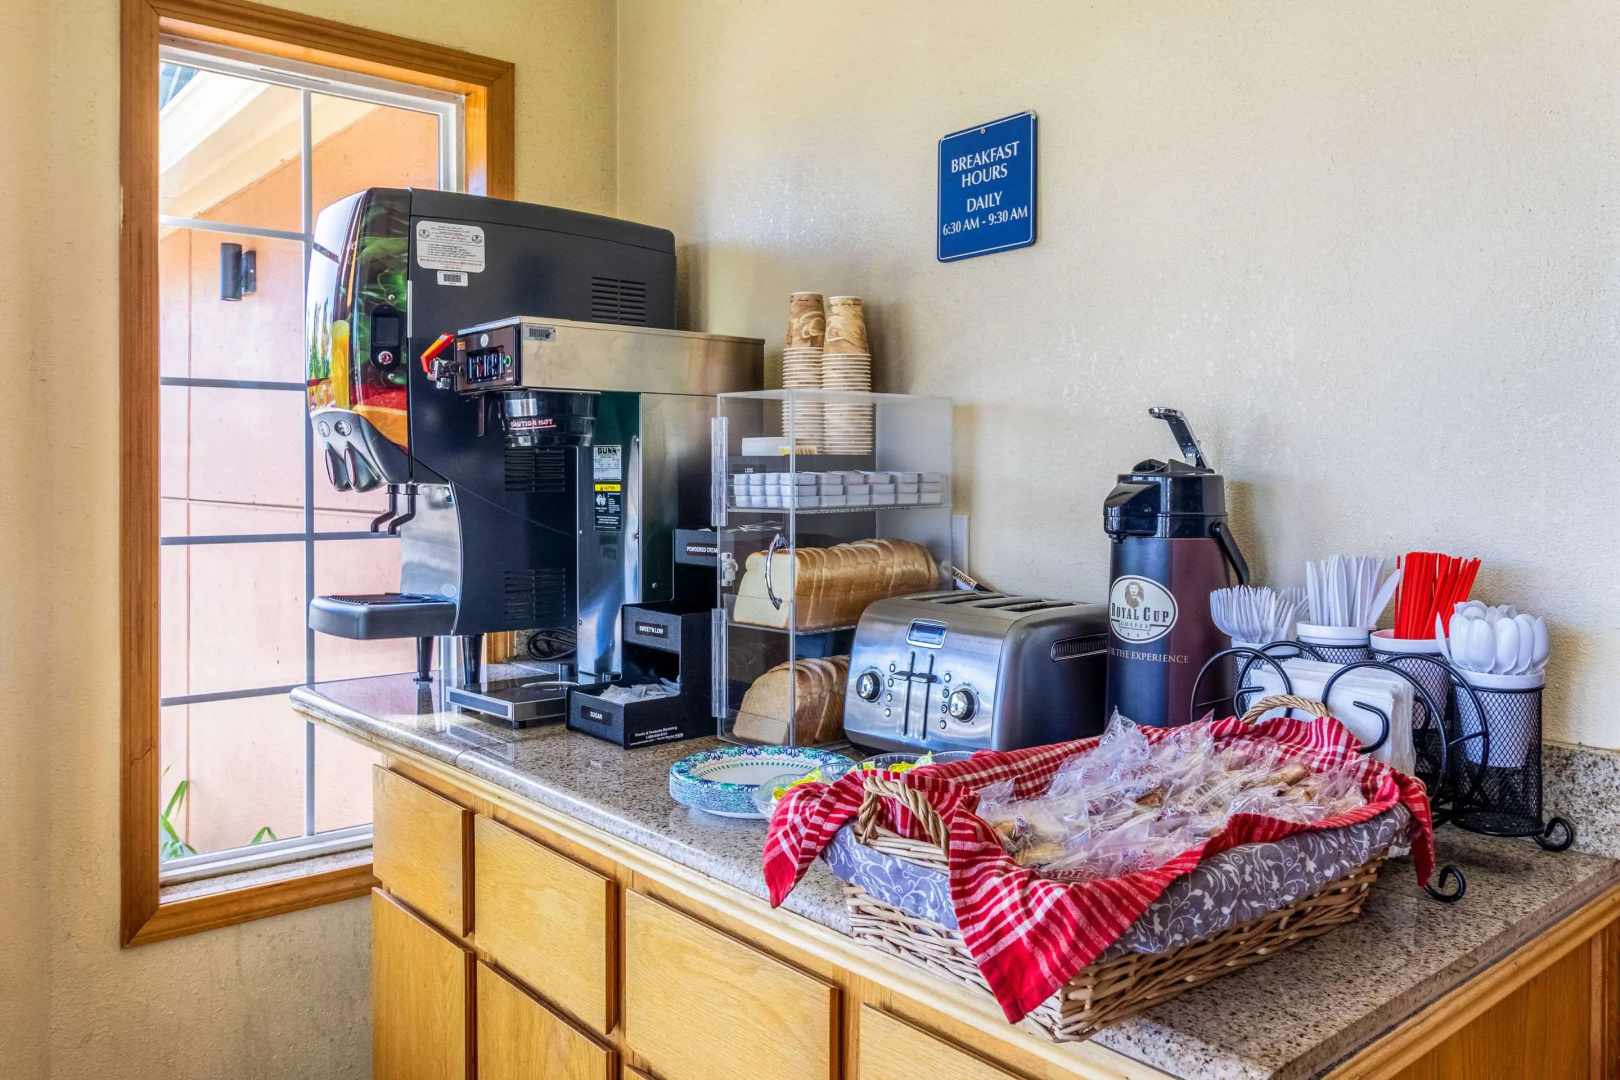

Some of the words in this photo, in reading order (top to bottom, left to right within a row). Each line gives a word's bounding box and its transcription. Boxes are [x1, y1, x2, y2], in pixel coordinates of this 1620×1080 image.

[951, 141, 1020, 173] BREAKFAST
[961, 162, 1008, 188] HOURS
[966, 191, 1003, 213] DAILY
[942, 220, 961, 236] 6:30
[962, 216, 980, 231] AM
[988, 209, 1009, 226] 9:30
[1010, 205, 1028, 221] AM
[510, 419, 537, 428] CAUTION
[538, 418, 553, 426] HOT
[1111, 602, 1140, 621] ROYAL
[1143, 606, 1169, 623] CUP
[655, 627, 664, 635] LOW
[1120, 620, 1149, 629] COFFEE
[1116, 648, 1130, 659] THE
[1131, 651, 1189, 664] EXPERIENCE
[590, 711, 603, 720] SUGAR
